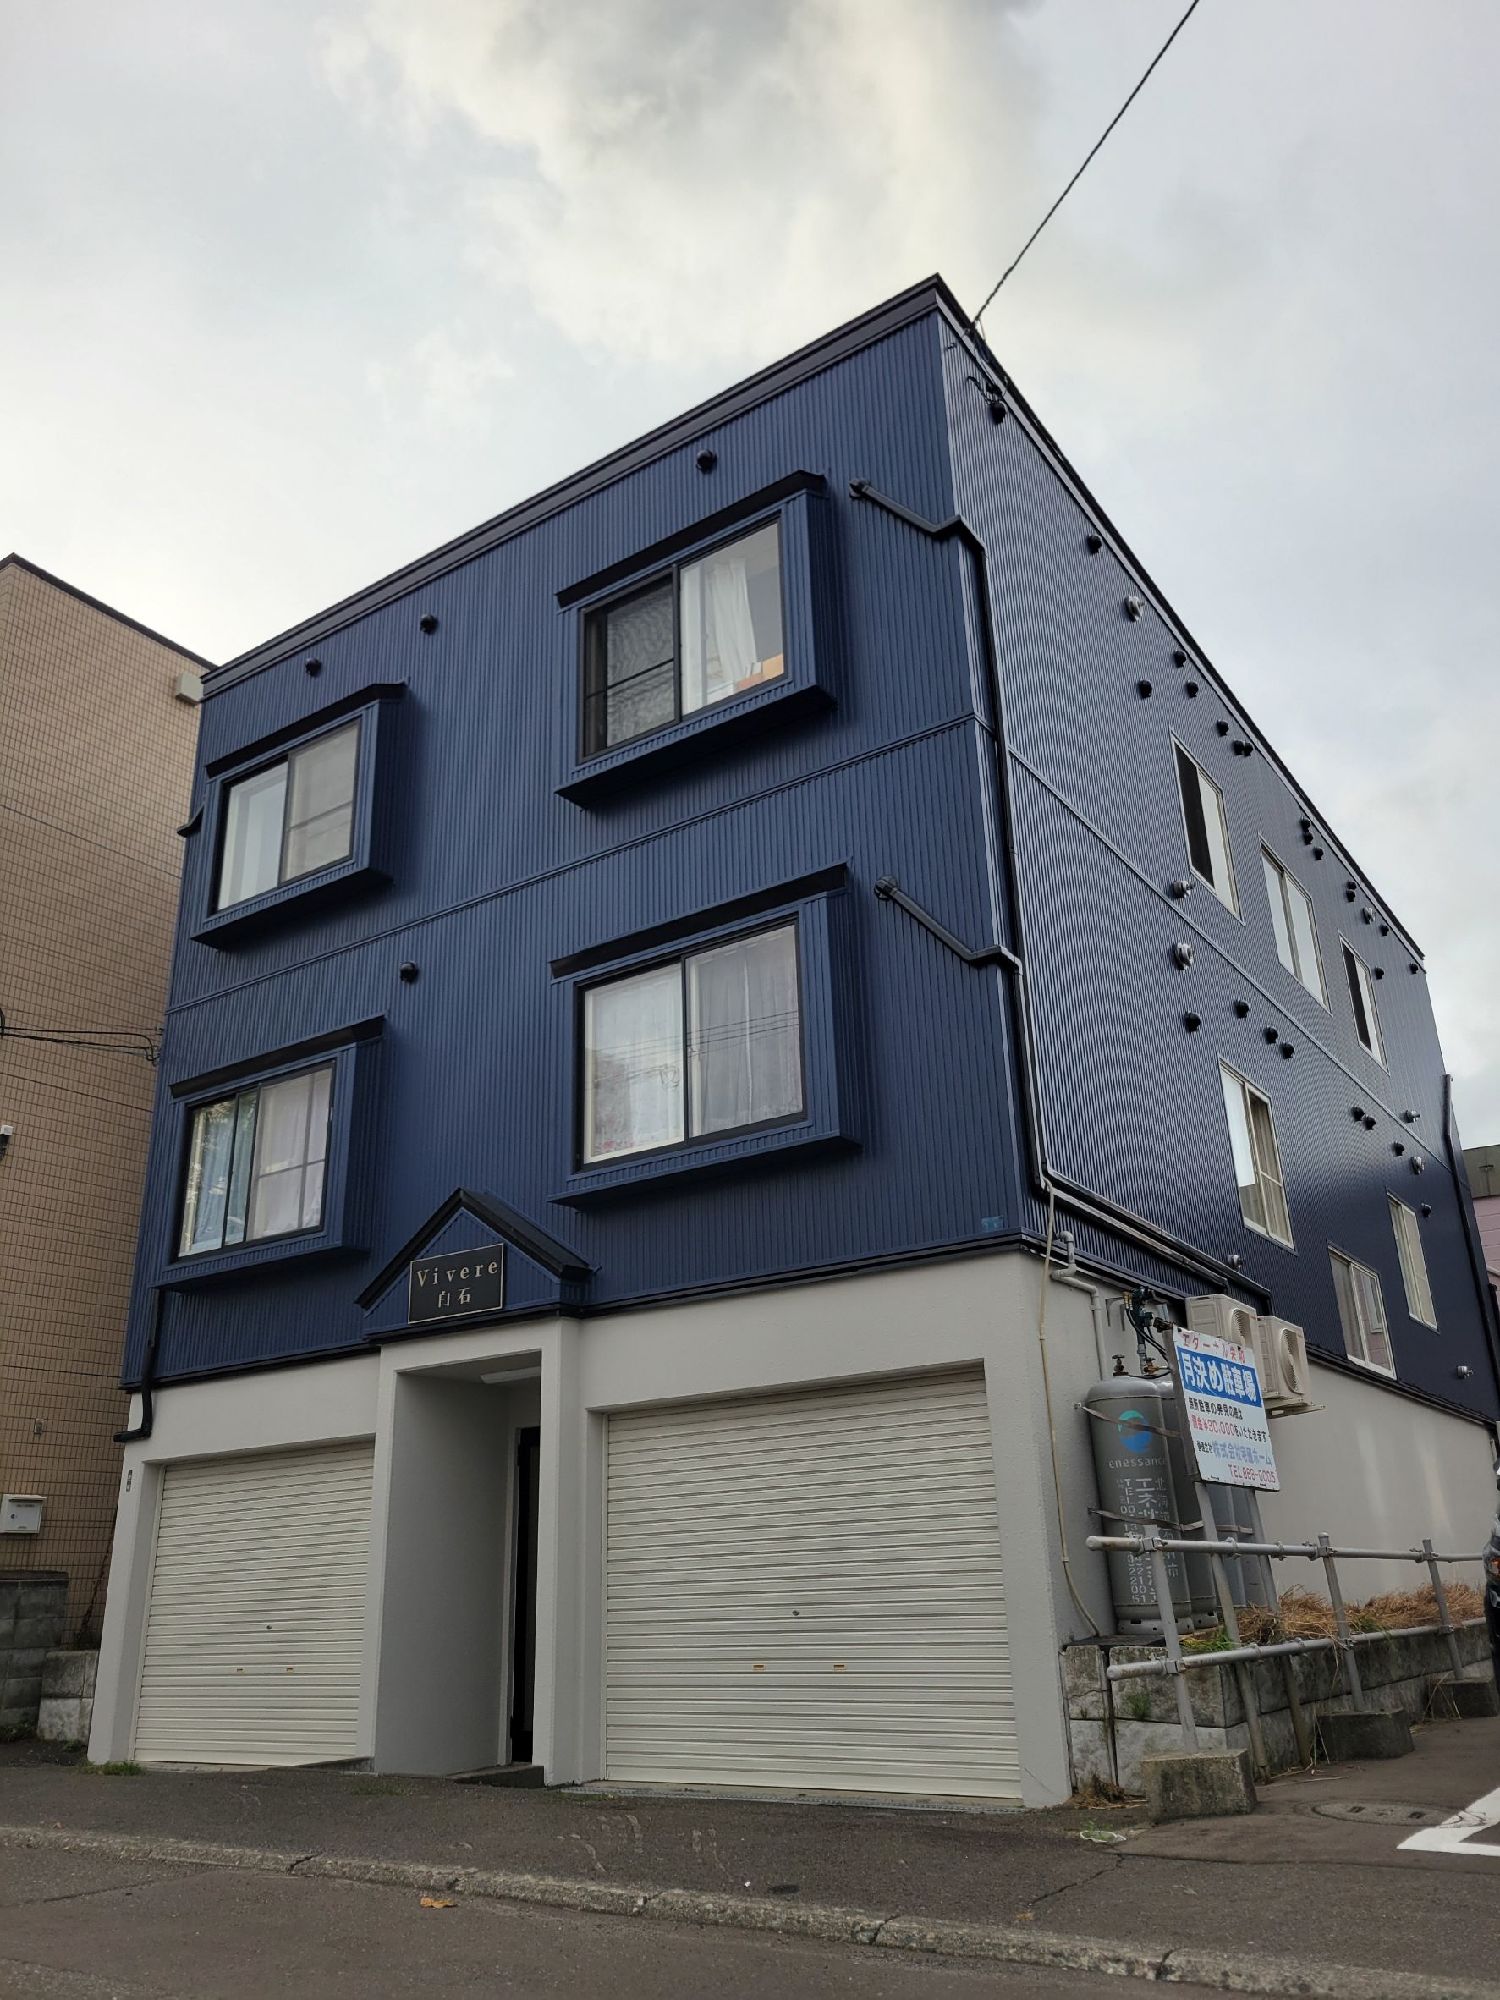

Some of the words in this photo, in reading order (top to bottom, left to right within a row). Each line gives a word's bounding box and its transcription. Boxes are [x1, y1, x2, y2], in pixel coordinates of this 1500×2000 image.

[417, 1261, 498, 1288] Vivere
[438, 1286, 471, 1309] 白石
[1181, 1352, 1257, 1403] 月決め駐車場
